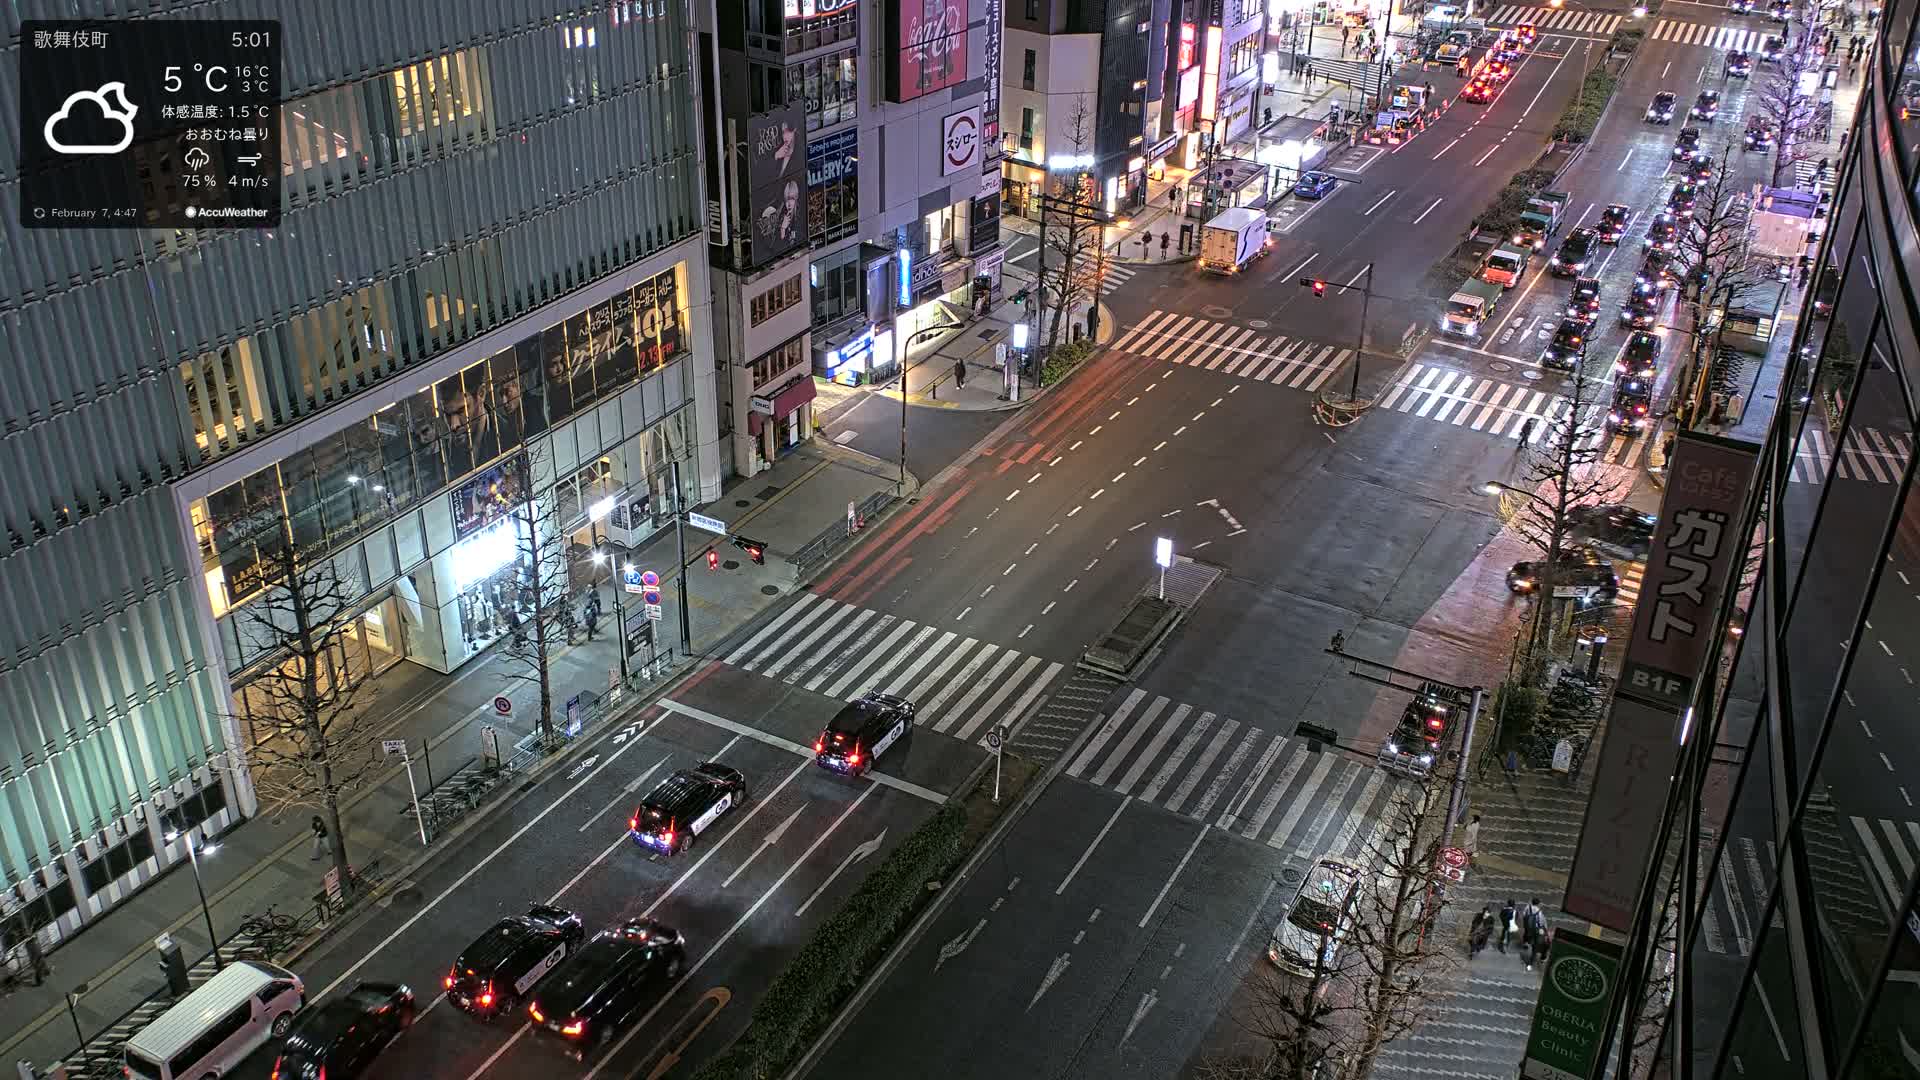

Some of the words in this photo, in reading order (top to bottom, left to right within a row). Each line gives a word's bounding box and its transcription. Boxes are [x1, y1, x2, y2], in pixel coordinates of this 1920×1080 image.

[946, 132, 978, 151] スシロー
[709, 200, 721, 233] MUJI
[594, 306, 611, 321] クリス
[613, 305, 633, 321] ラファロ
[616, 295, 632, 308] マーク
[630, 300, 675, 348] 101
[1650, 510, 1726, 641] ガスト
[1632, 669, 1681, 696] B1F
[1541, 1005, 1595, 1032] OBERIA
[1541, 1021, 1590, 1046] Beauty
[1540, 1039, 1583, 1061] Clinic
